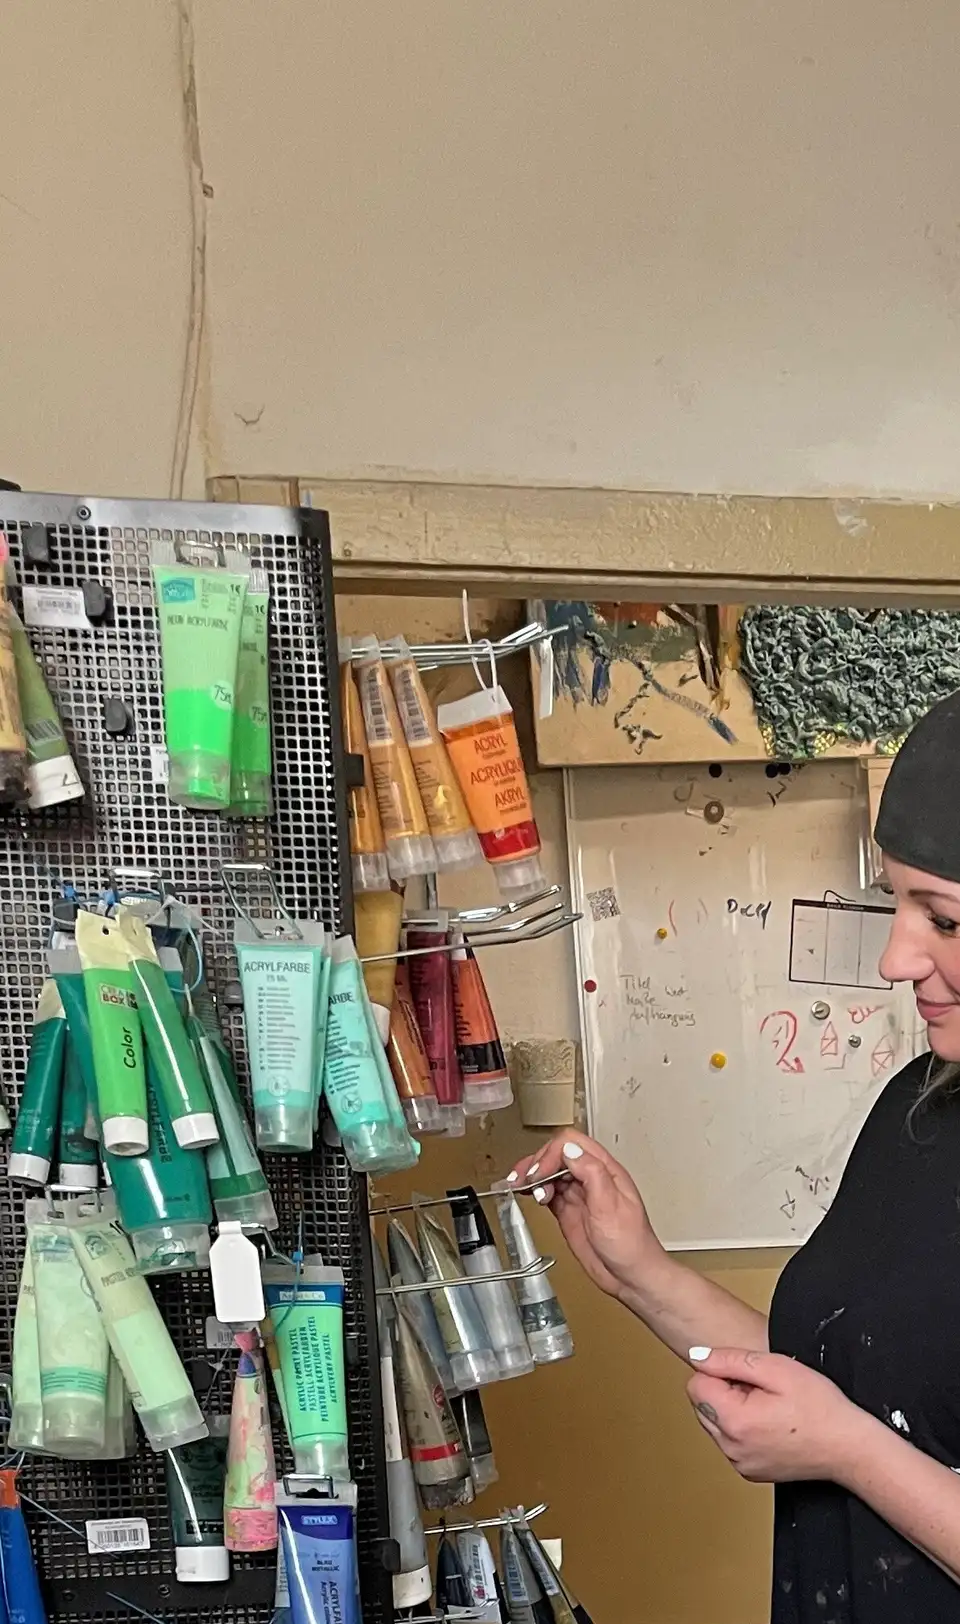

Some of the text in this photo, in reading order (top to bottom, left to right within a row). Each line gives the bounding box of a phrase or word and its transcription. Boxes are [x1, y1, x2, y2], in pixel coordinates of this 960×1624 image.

[473, 734, 508, 753] ACRYL
[494, 786, 525, 808] AKRYL
[243, 961, 312, 974] ACRYLFARBE
[121, 1026, 137, 1069] Color
